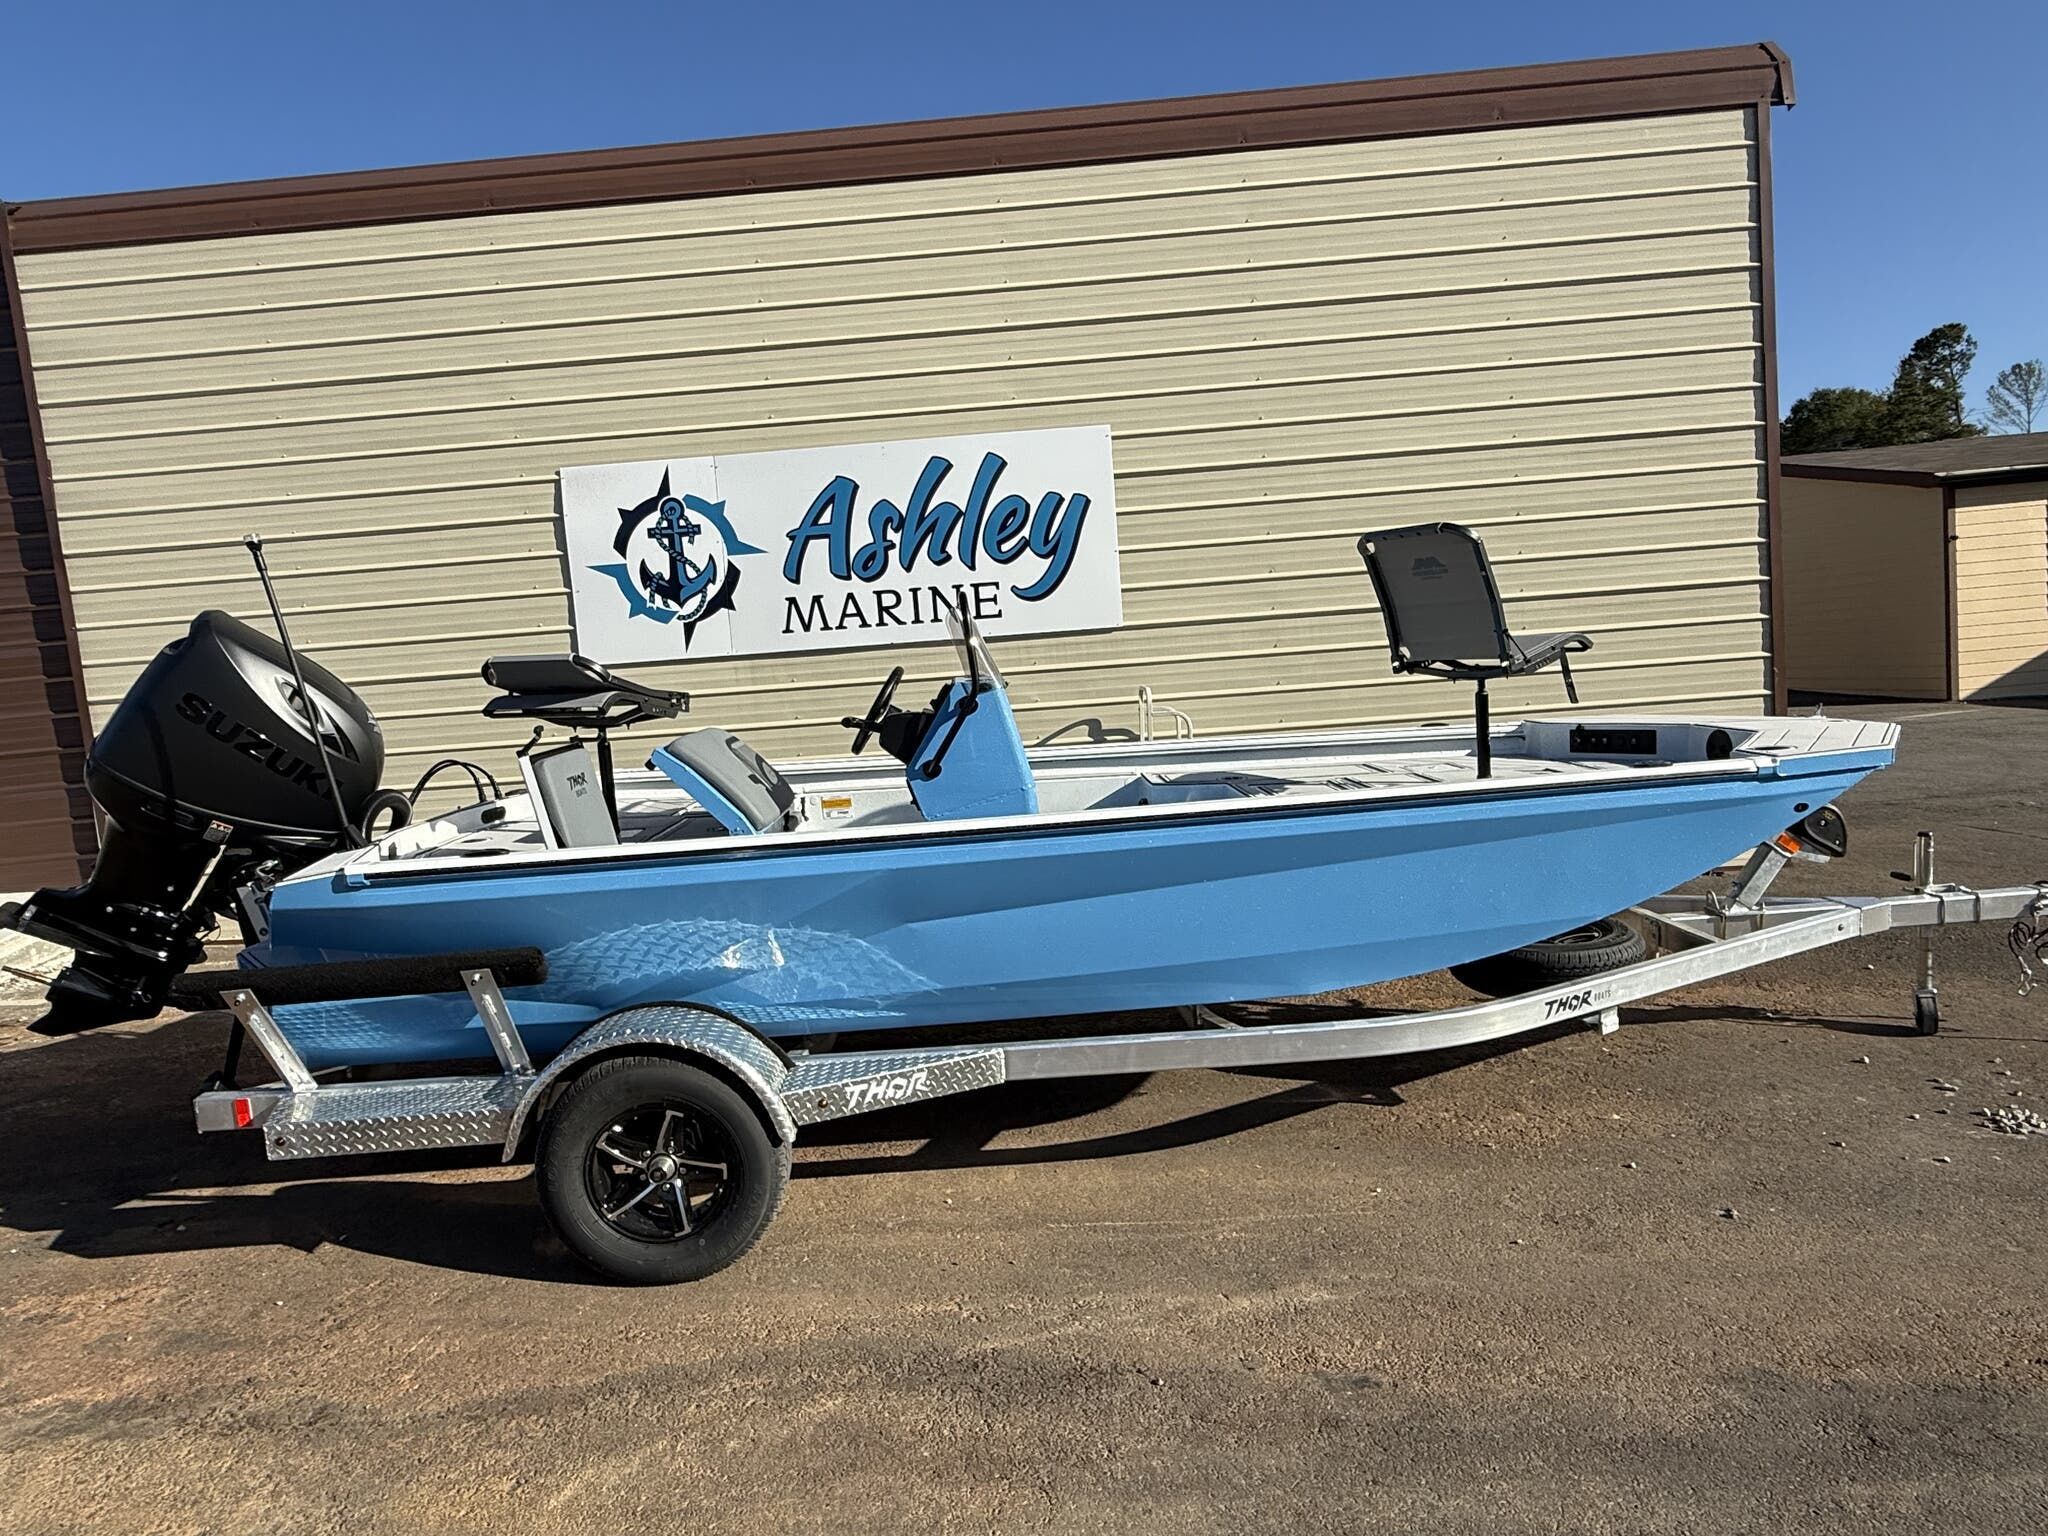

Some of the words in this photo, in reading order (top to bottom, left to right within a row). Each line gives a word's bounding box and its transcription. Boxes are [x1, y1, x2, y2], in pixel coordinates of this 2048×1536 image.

[783, 451, 1092, 601] Ashley
[782, 581, 1003, 634] MARINE
[1544, 989, 1593, 1020] THOR
[844, 1070, 930, 1110] THOR
